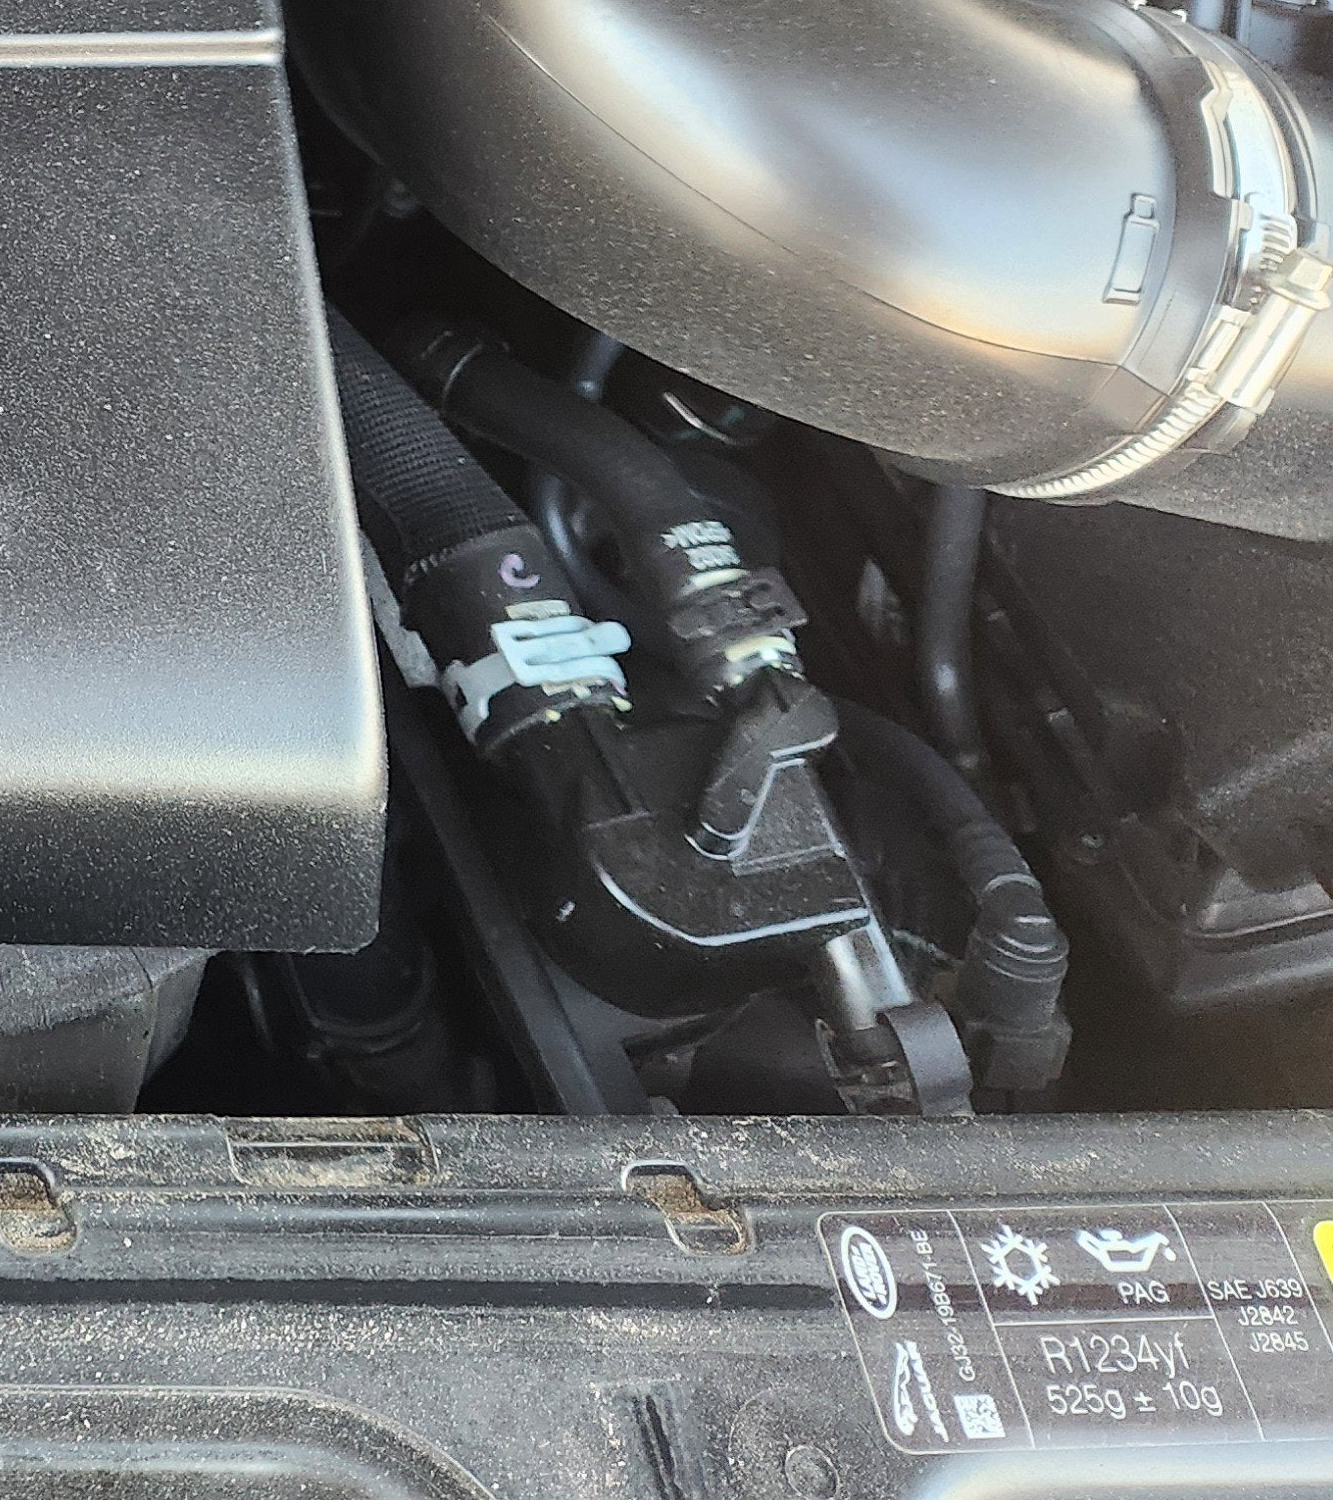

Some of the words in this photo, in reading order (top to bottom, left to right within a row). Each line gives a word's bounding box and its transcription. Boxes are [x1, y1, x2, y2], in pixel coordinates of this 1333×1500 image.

[1118, 1280, 1170, 1304] PAG
[1207, 1279, 1253, 1301] SAE
[1255, 1278, 1303, 1299] J639
[1238, 1305, 1299, 1326] J2842
[1250, 1331, 1309, 1353] J2845
[1040, 1331, 1190, 1379] R1234yf
[1046, 1383, 1126, 1420] 525g
[1162, 1380, 1223, 1417] 10g
